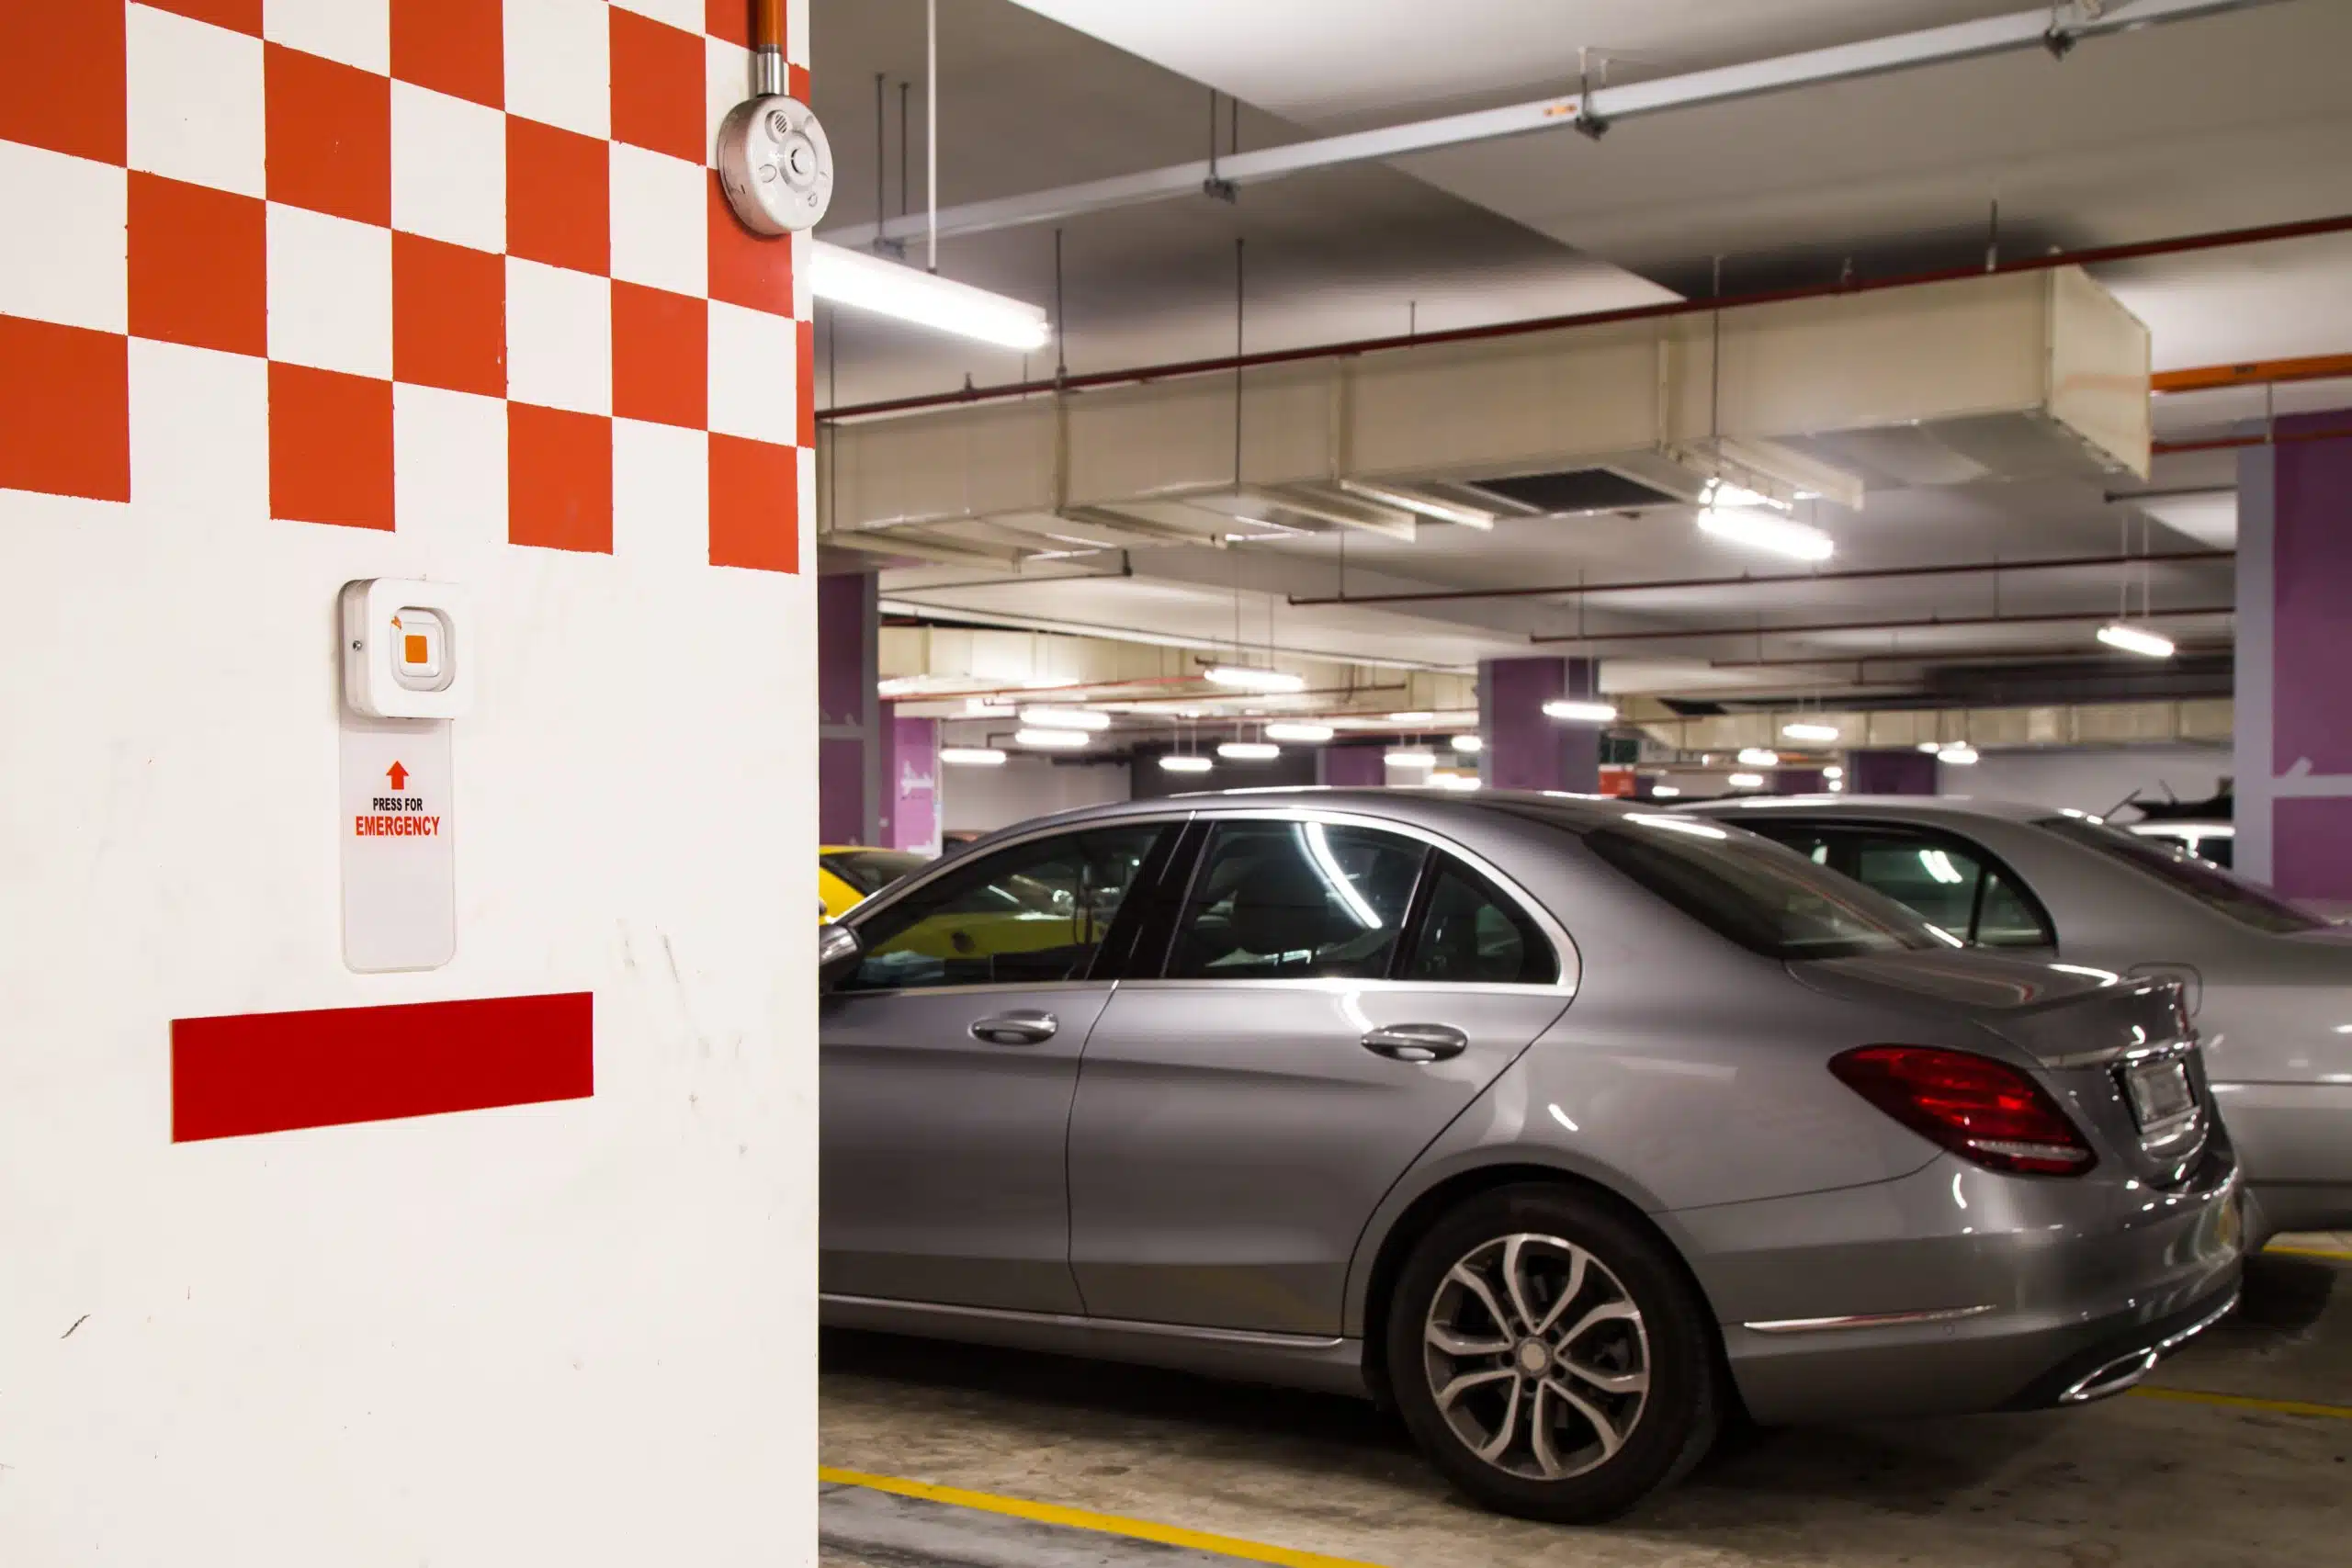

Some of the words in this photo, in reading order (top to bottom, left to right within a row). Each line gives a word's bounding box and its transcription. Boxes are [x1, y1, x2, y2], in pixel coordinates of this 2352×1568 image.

[372, 797, 402, 811] PRESS
[404, 797, 424, 811] FOR
[356, 816, 440, 836] EMERGENCY
